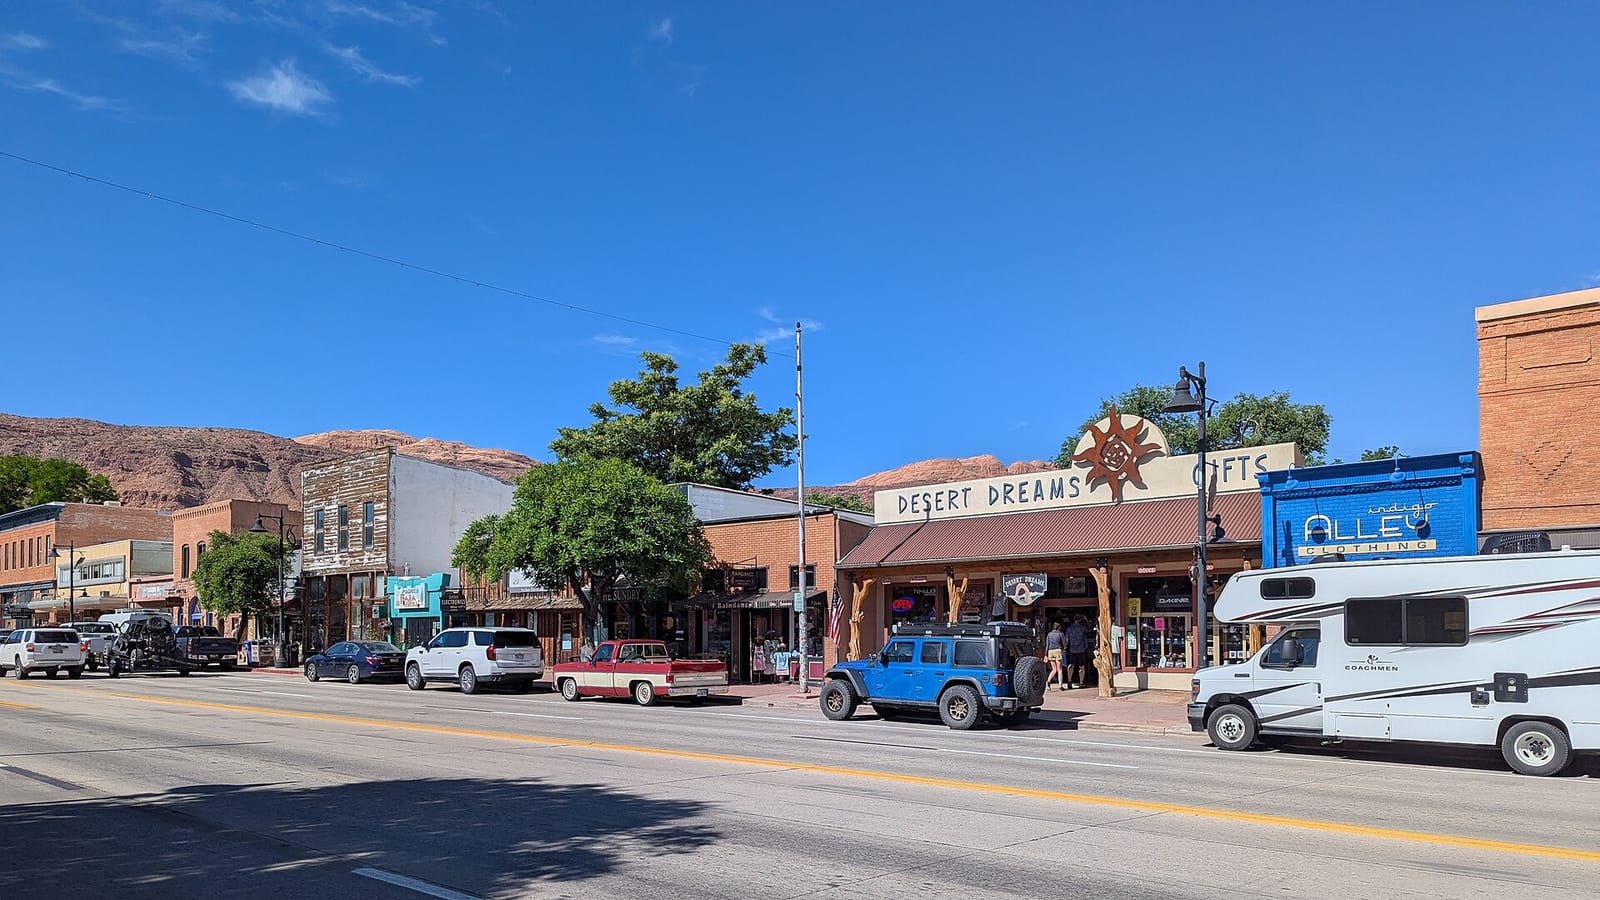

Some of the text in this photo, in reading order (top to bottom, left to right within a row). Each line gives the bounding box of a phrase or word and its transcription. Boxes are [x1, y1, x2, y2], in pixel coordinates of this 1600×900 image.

[898, 487, 972, 514] DESERT
[988, 476, 1080, 506] DREAMS
[1367, 502, 1440, 518] indigo
[1304, 513, 1429, 542] ALLEY
[1306, 541, 1428, 554] CLOTHING
[613, 589, 640, 600] SUNDRY
[892, 599, 913, 610] OPEN
